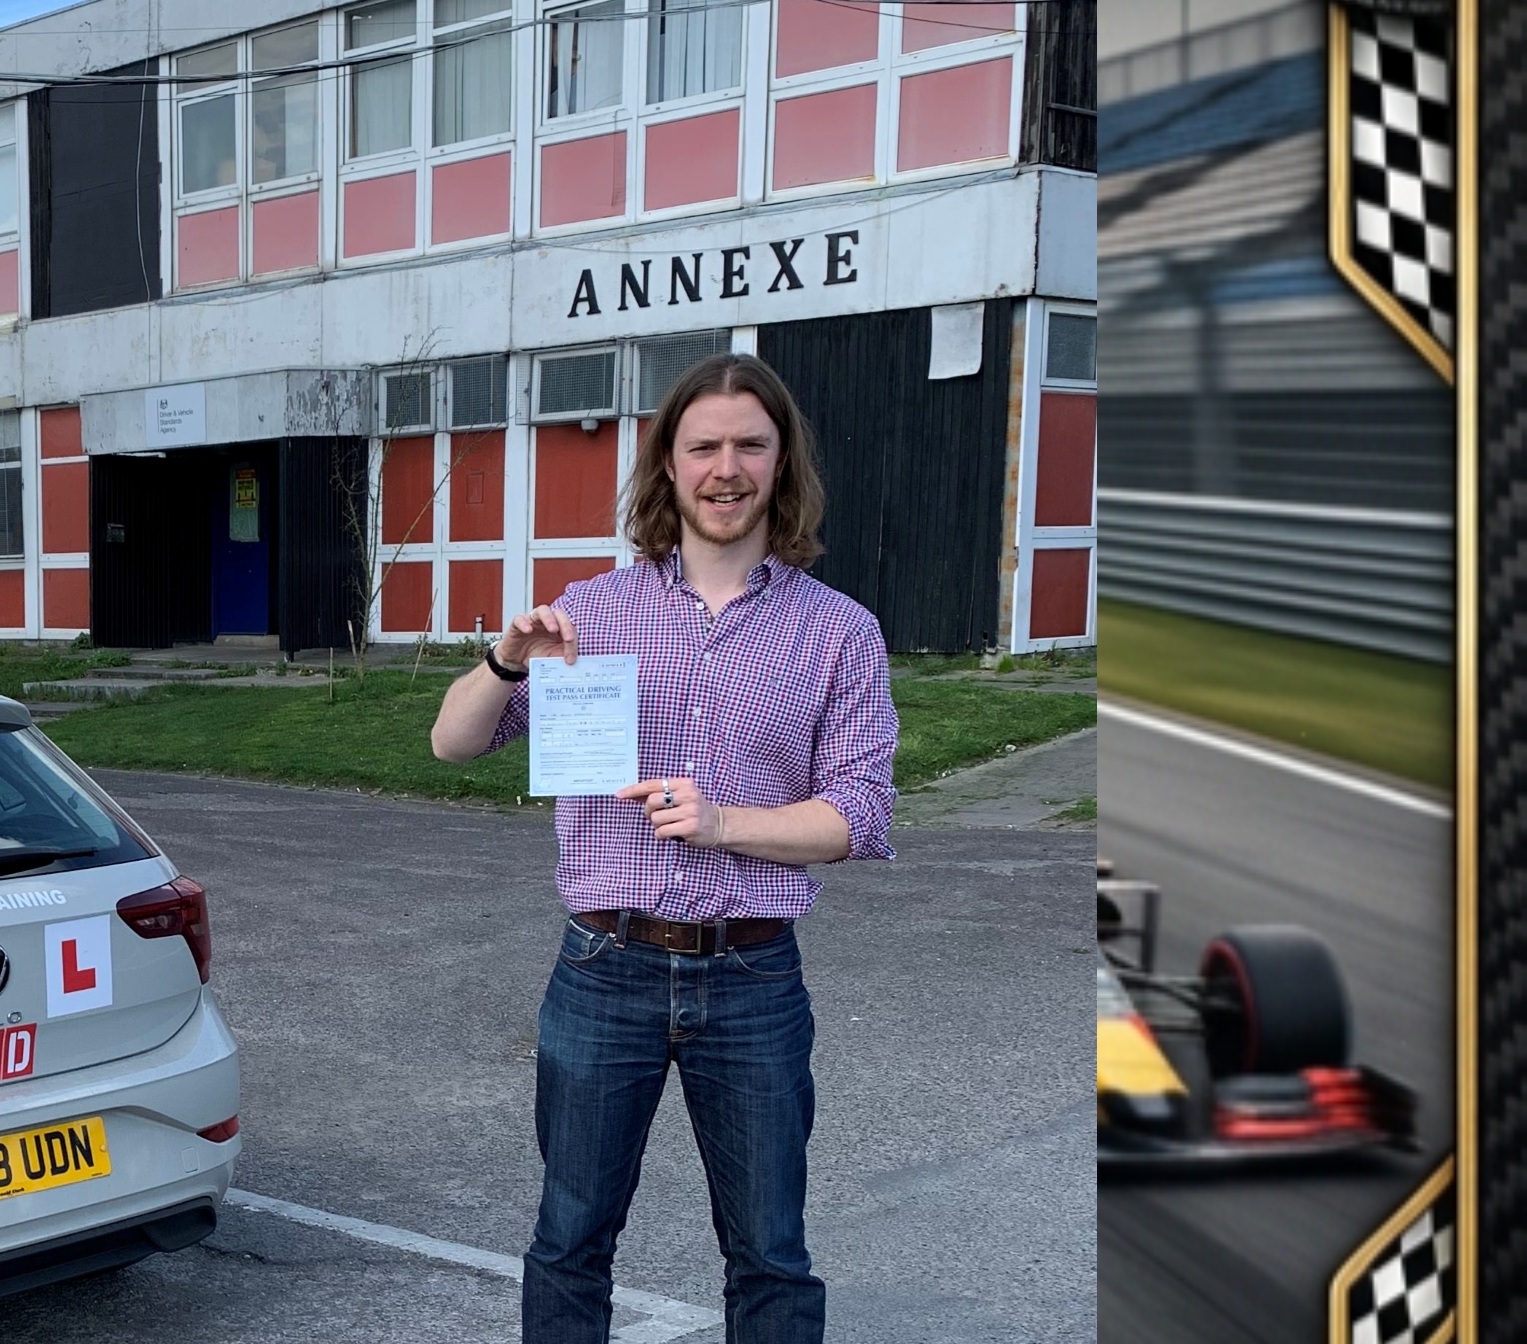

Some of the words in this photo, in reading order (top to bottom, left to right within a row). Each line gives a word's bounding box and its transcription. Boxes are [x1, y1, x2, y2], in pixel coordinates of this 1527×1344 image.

[567, 229, 860, 319] ANNEXE
[61, 938, 97, 994] L
[20, 1124, 95, 1180] UDN
